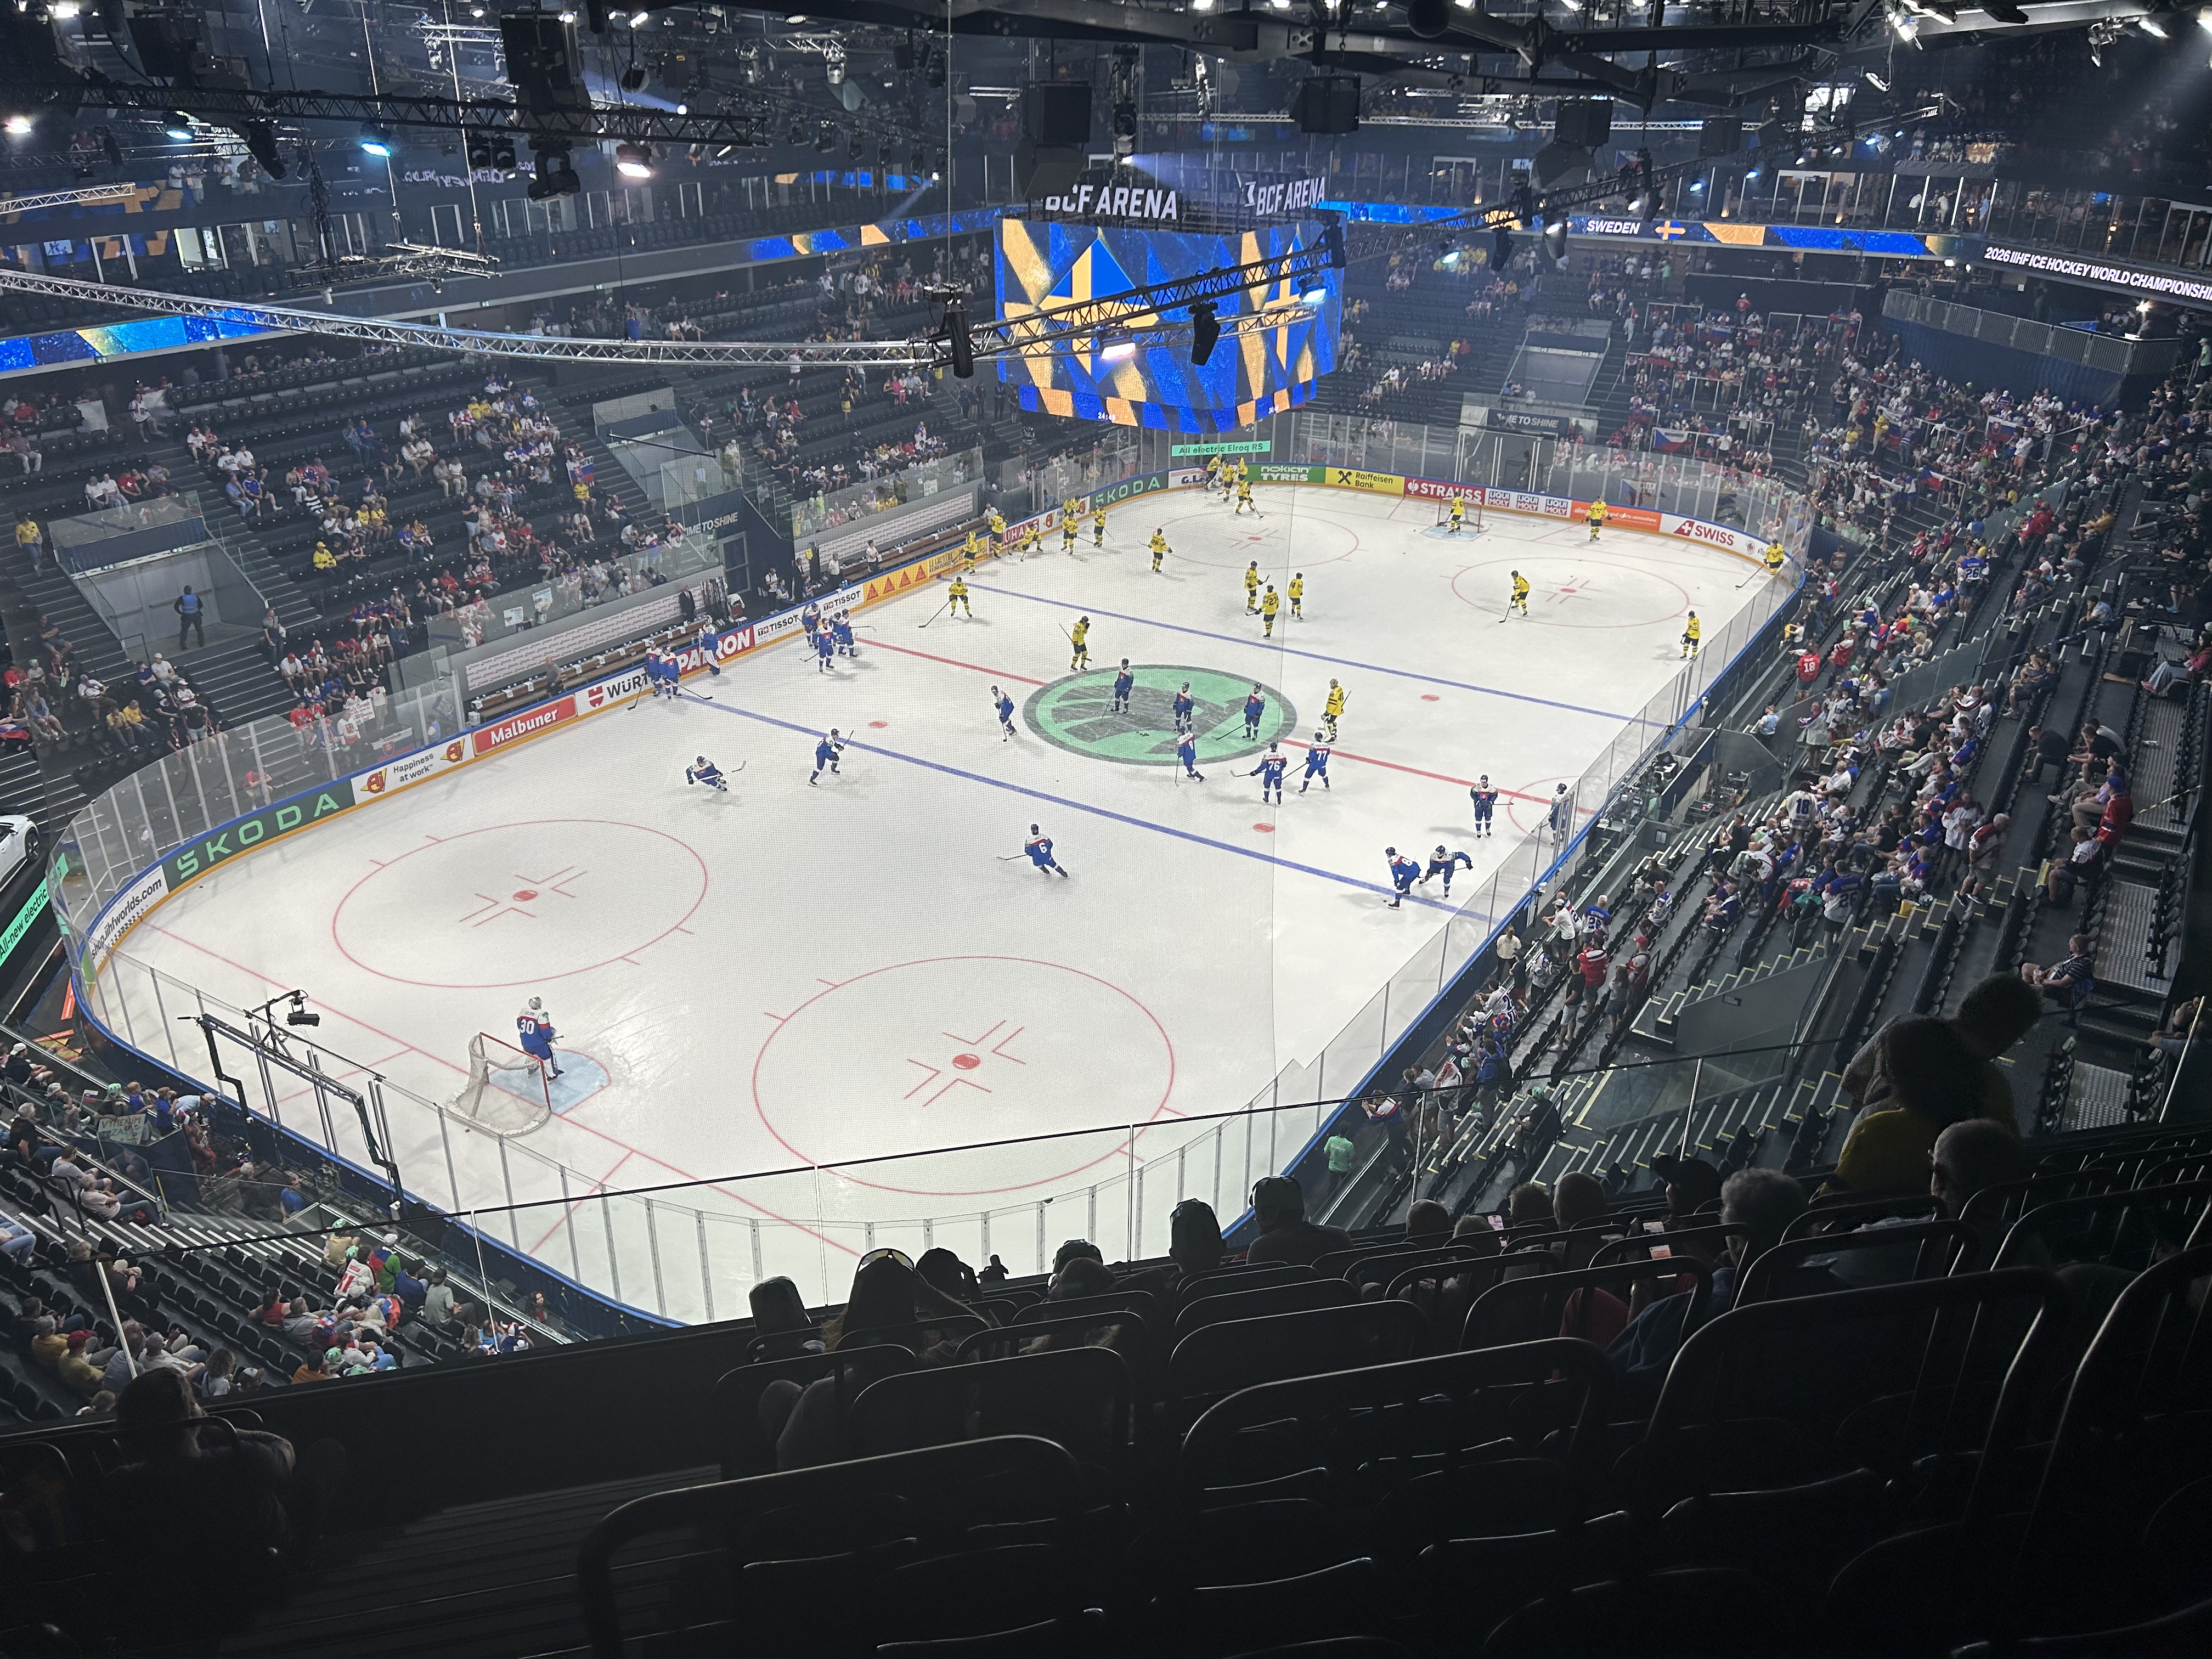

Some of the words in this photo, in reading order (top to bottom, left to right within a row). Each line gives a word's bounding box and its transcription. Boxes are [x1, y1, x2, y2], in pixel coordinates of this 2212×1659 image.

[1095, 186, 1177, 219] ARENA
[1256, 183, 1284, 216] BCF
[1284, 177, 1325, 211] ARENA
[1587, 220, 1640, 234] SWEDEN
[1984, 246, 2011, 262] 2026
[2009, 251, 2030, 266] IIHF
[2029, 255, 2048, 269] ICE
[2046, 257, 2091, 276] HOCKEY
[2090, 265, 2131, 284] WORLD
[1519, 415, 1531, 425] TO
[1531, 417, 1559, 428] SHINE
[1193, 445, 1225, 454] electric
[1228, 444, 1249, 453] Elroq
[1261, 473, 1308, 482] TYRES
[1356, 472, 1393, 484] Raiffeisen
[1355, 479, 1374, 489] Bank
[1489, 490, 1510, 500] LIQUI
[1517, 494, 1538, 504] LIQUI
[1488, 498, 1509, 507] MOLY
[1516, 502, 1538, 511] MOLY
[1547, 499, 1568, 508] LIQUI
[1545, 506, 1567, 515] MOLY
[702, 520, 713, 532] TO
[714, 512, 738, 528] SHINE
[1695, 524, 1734, 546] SWISS
[1966, 568, 1979, 578] 26
[834, 590, 861, 606] TISSOT
[1268, 596, 1277, 606] 23
[769, 614, 799, 631] TISSOT
[1803, 662, 1815, 673] 18
[607, 672, 648, 698] WÜRT
[490, 708, 558, 746] Malbuner
[1316, 750, 1328, 761] 77
[393, 753, 434, 774] Happiness
[1268, 760, 1281, 771] 76
[399, 774, 409, 782] at
[1796, 798, 1810, 815] 18
[1039, 842, 1048, 854] 6
[0, 919, 24, 960] All-new
[24, 889, 47, 924] electric
[92, 879, 162, 960] shop.iihfworlds.com
[520, 1019, 535, 1035] 30
